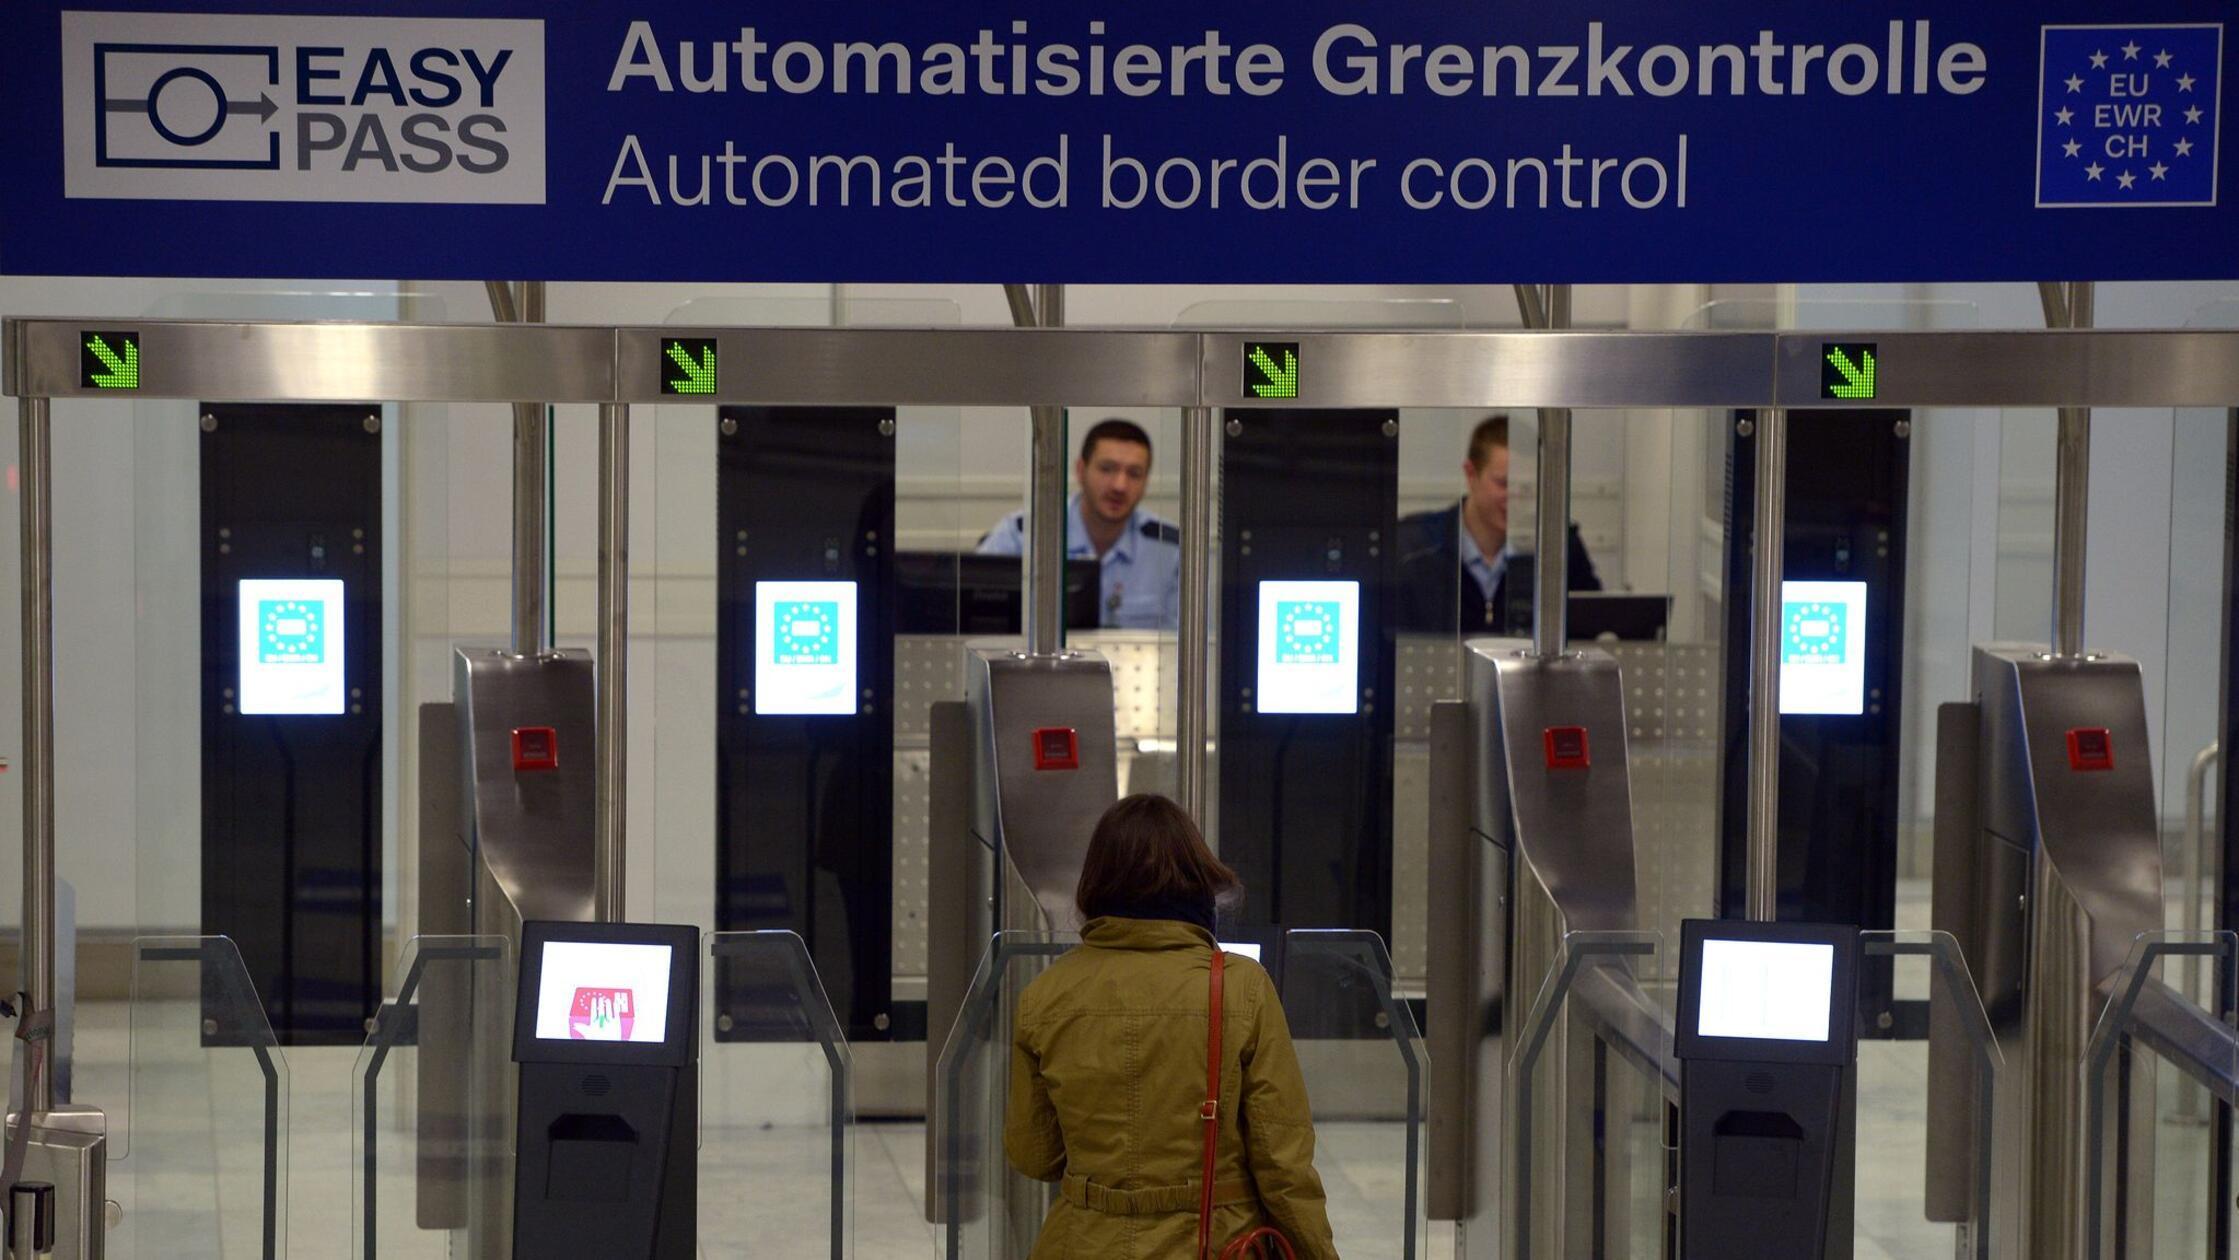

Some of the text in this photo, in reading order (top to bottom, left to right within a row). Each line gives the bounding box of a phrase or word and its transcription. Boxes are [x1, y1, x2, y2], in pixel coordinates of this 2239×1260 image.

[297, 47, 513, 108] EASY
[608, 20, 1986, 96] Automatisierte Grenzkontrolle
[2111, 74, 2148, 97] EU
[296, 112, 509, 174] PASS
[2095, 104, 2162, 128] EWR
[2106, 134, 2148, 158] CH
[602, 134, 1687, 209] Automated border control
